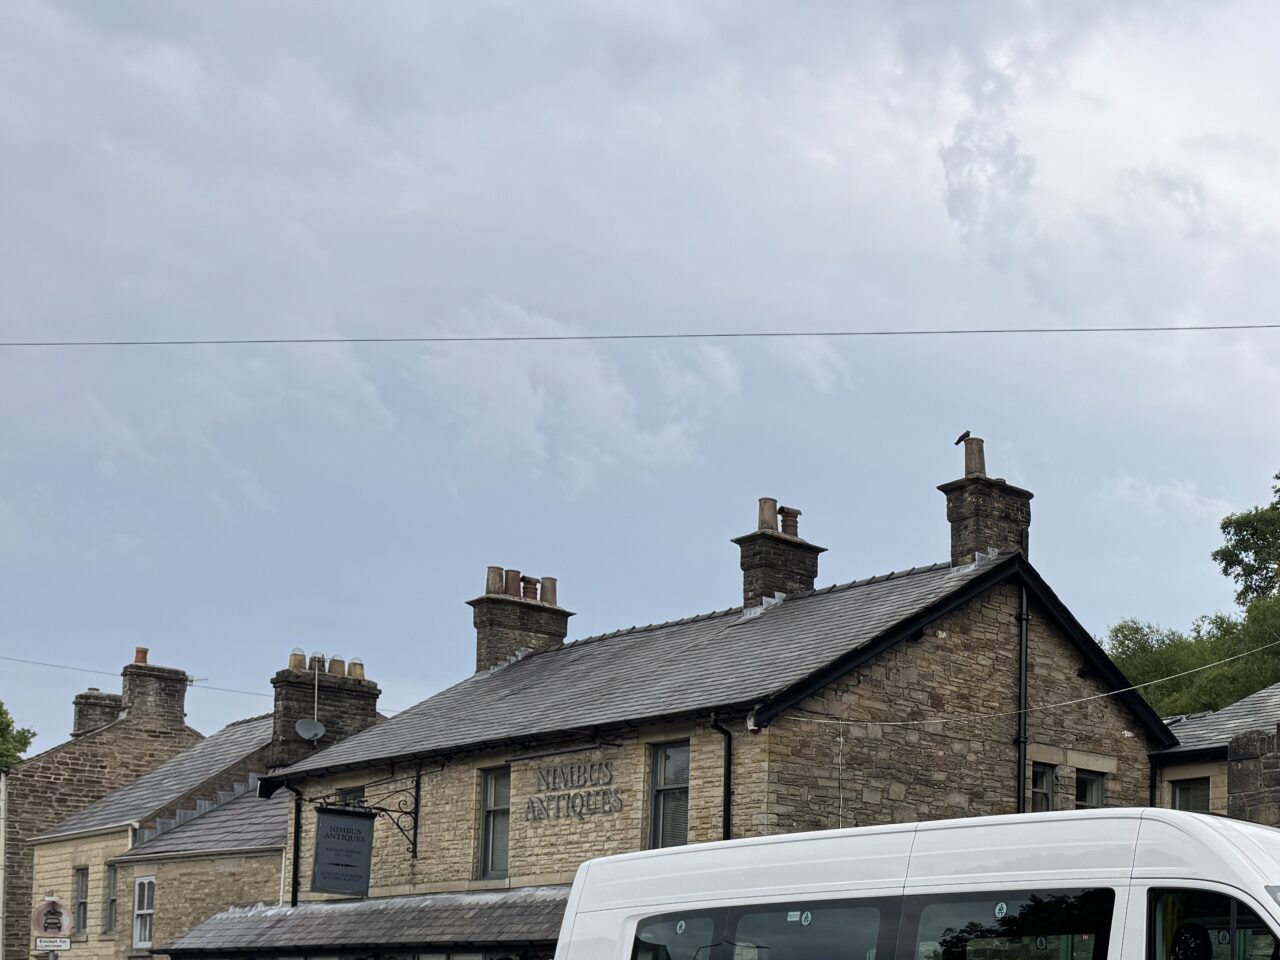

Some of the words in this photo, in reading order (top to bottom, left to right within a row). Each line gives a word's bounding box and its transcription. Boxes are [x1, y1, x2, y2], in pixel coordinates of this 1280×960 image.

[536, 761, 614, 792] NIMBUS
[525, 787, 623, 821] ANTIQUES
[324, 833, 366, 842] ANTIQUES
[329, 825, 362, 835] NIMBUS
